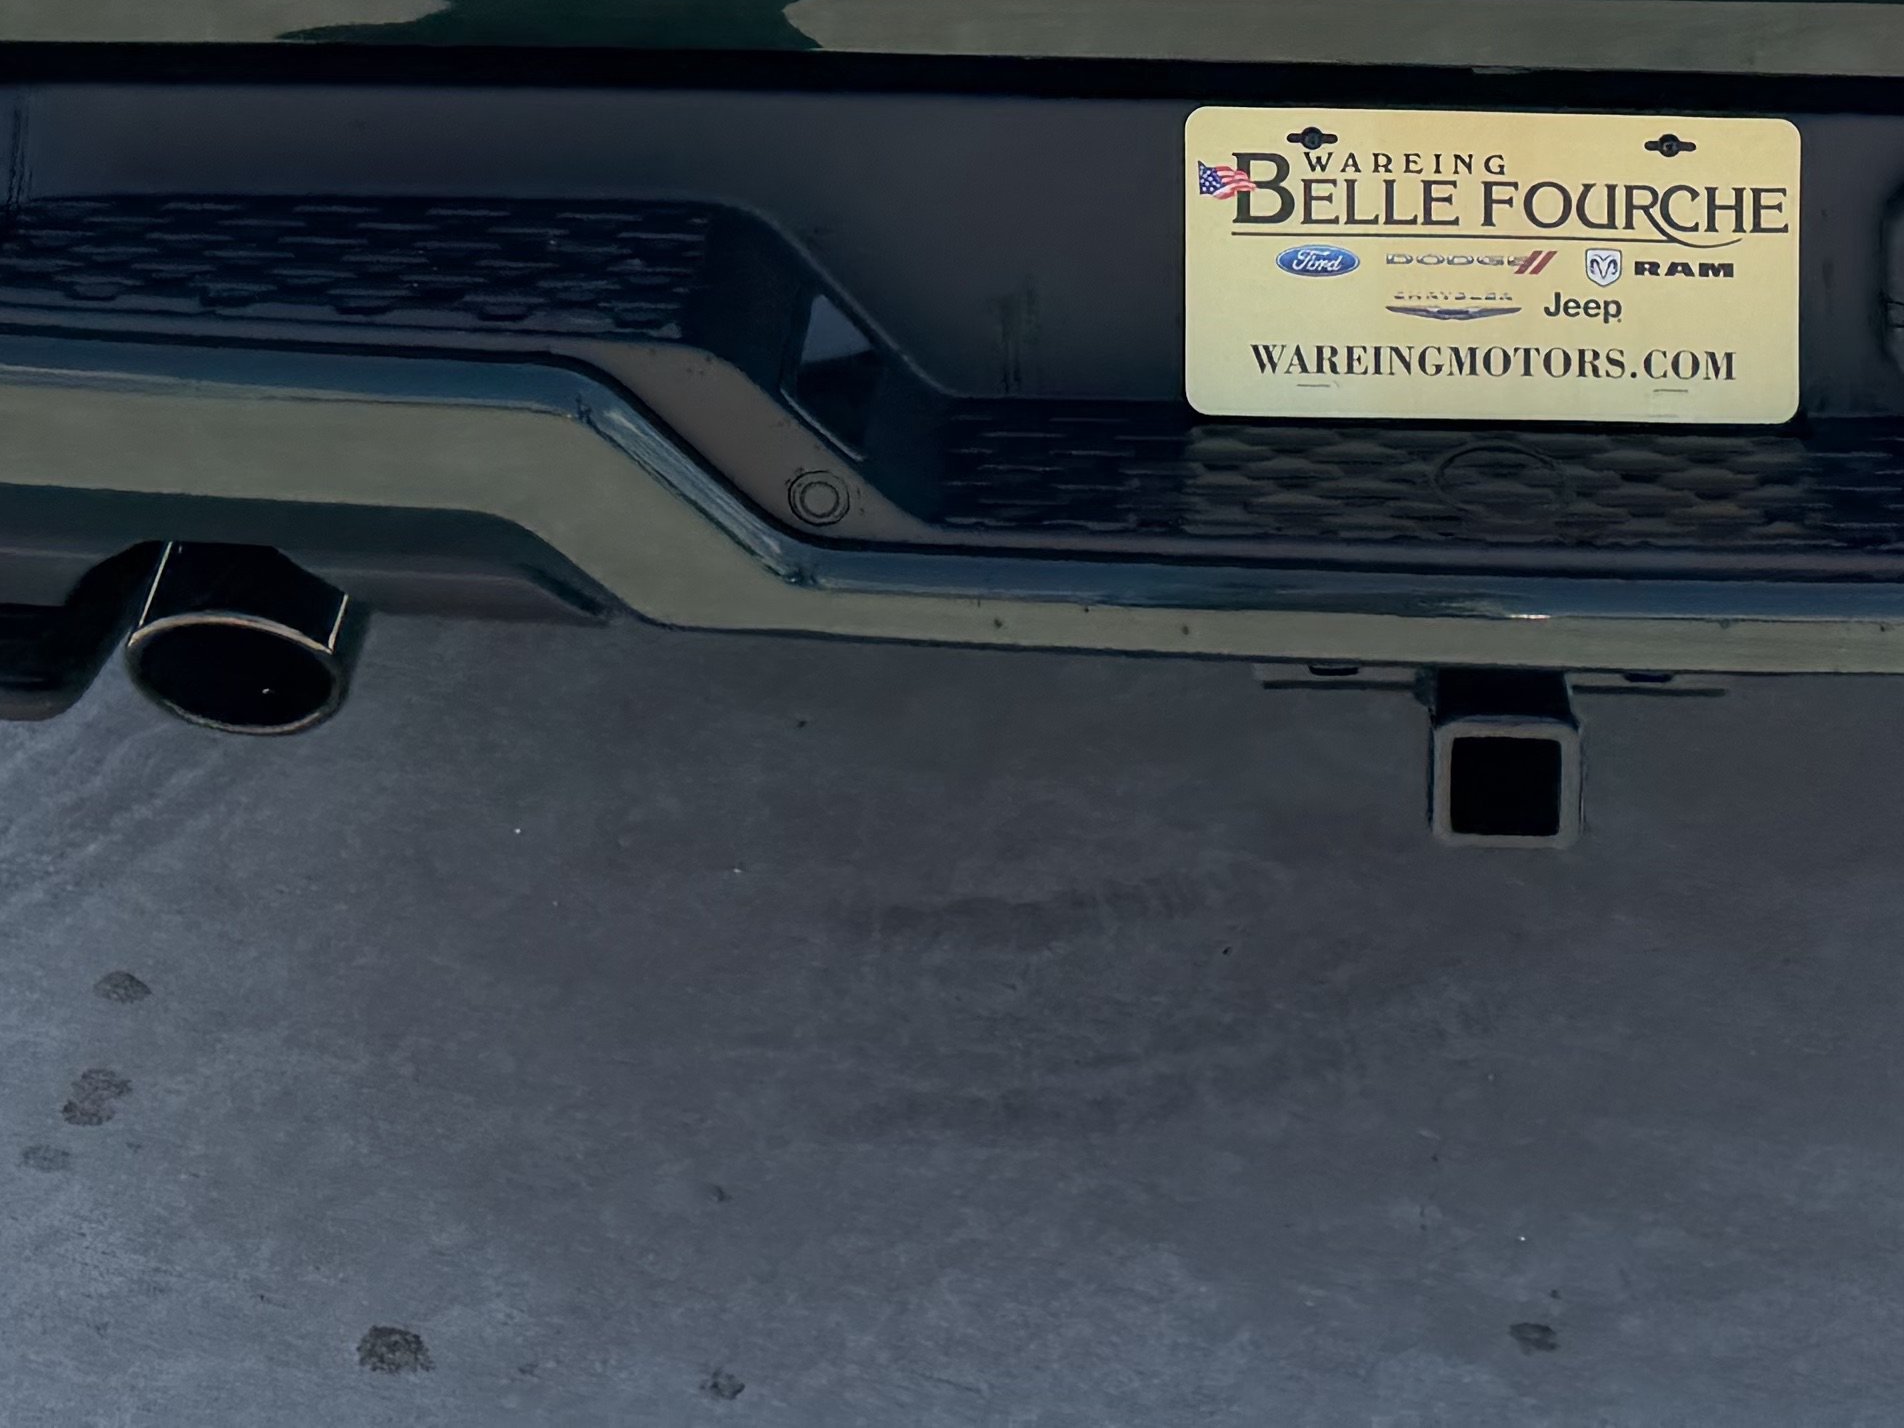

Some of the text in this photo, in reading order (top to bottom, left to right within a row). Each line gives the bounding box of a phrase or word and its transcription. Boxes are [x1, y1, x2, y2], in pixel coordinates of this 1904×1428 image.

[1304, 151, 1508, 177] WAREING
[1231, 151, 1790, 243] BELLE FOURCHE
[1290, 248, 1345, 273] Ford
[1385, 253, 1530, 268] DODGE
[1633, 260, 1735, 280] RAM
[1543, 291, 1623, 324] Jeep
[1250, 343, 1737, 382] WAREINGMOTORS.COM
